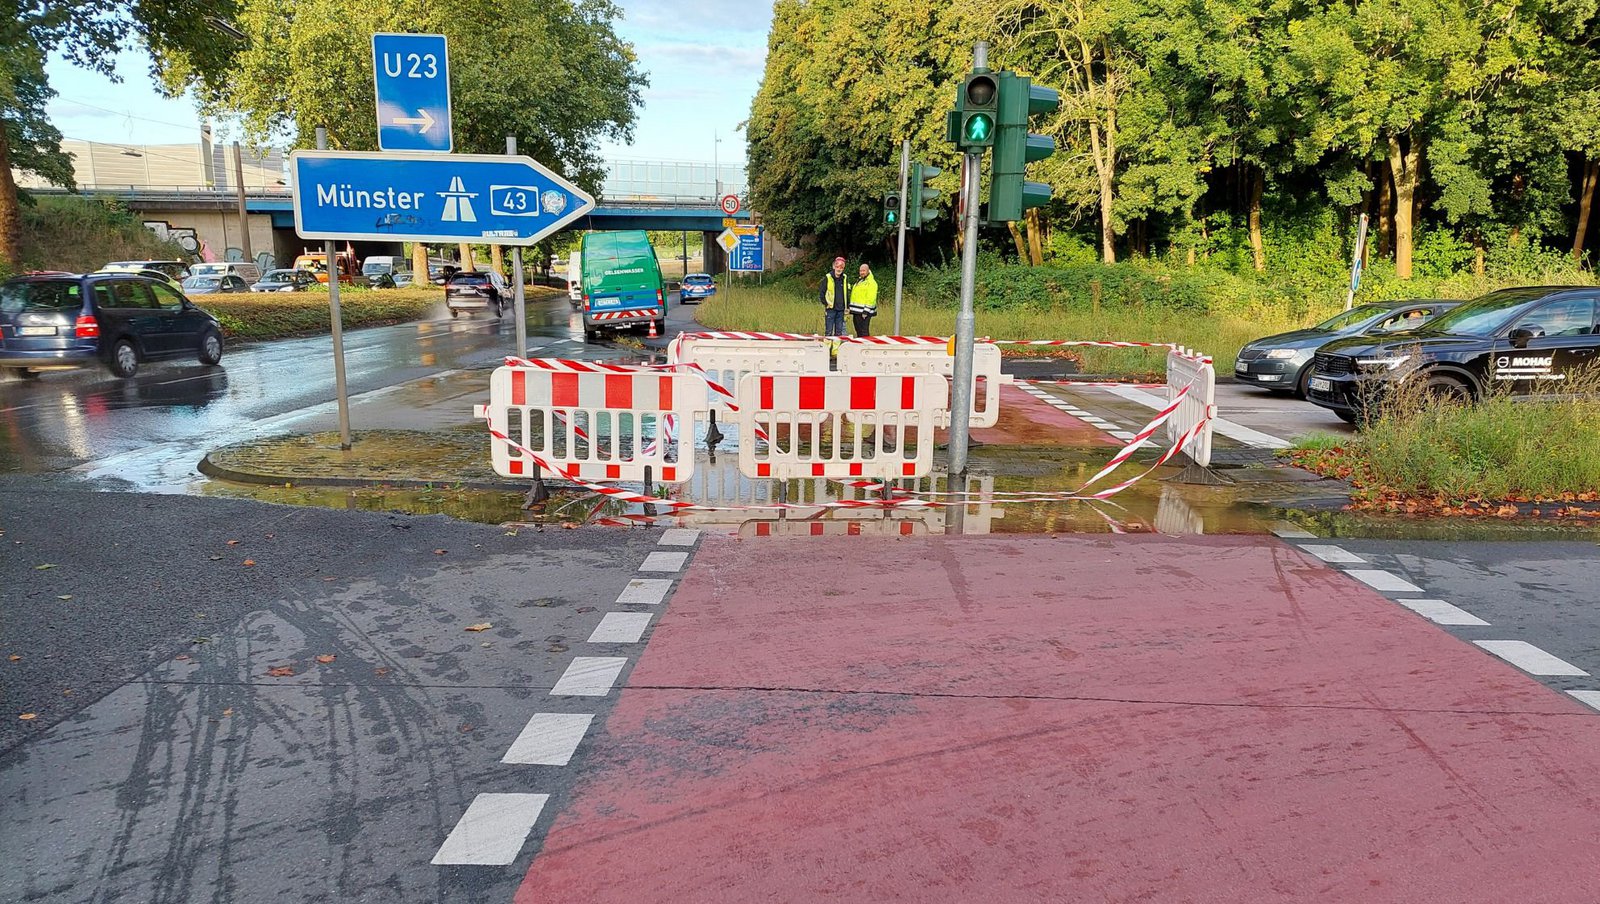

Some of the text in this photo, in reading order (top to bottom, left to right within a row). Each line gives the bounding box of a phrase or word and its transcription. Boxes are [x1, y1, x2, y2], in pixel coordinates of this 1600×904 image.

[384, 52, 438, 79] U 23
[316, 183, 424, 210] Münster
[503, 192, 527, 211] 43
[725, 199, 736, 209] 50
[605, 268, 644, 276] GELSENWASSER
[1512, 357, 1553, 367] MOHAG
